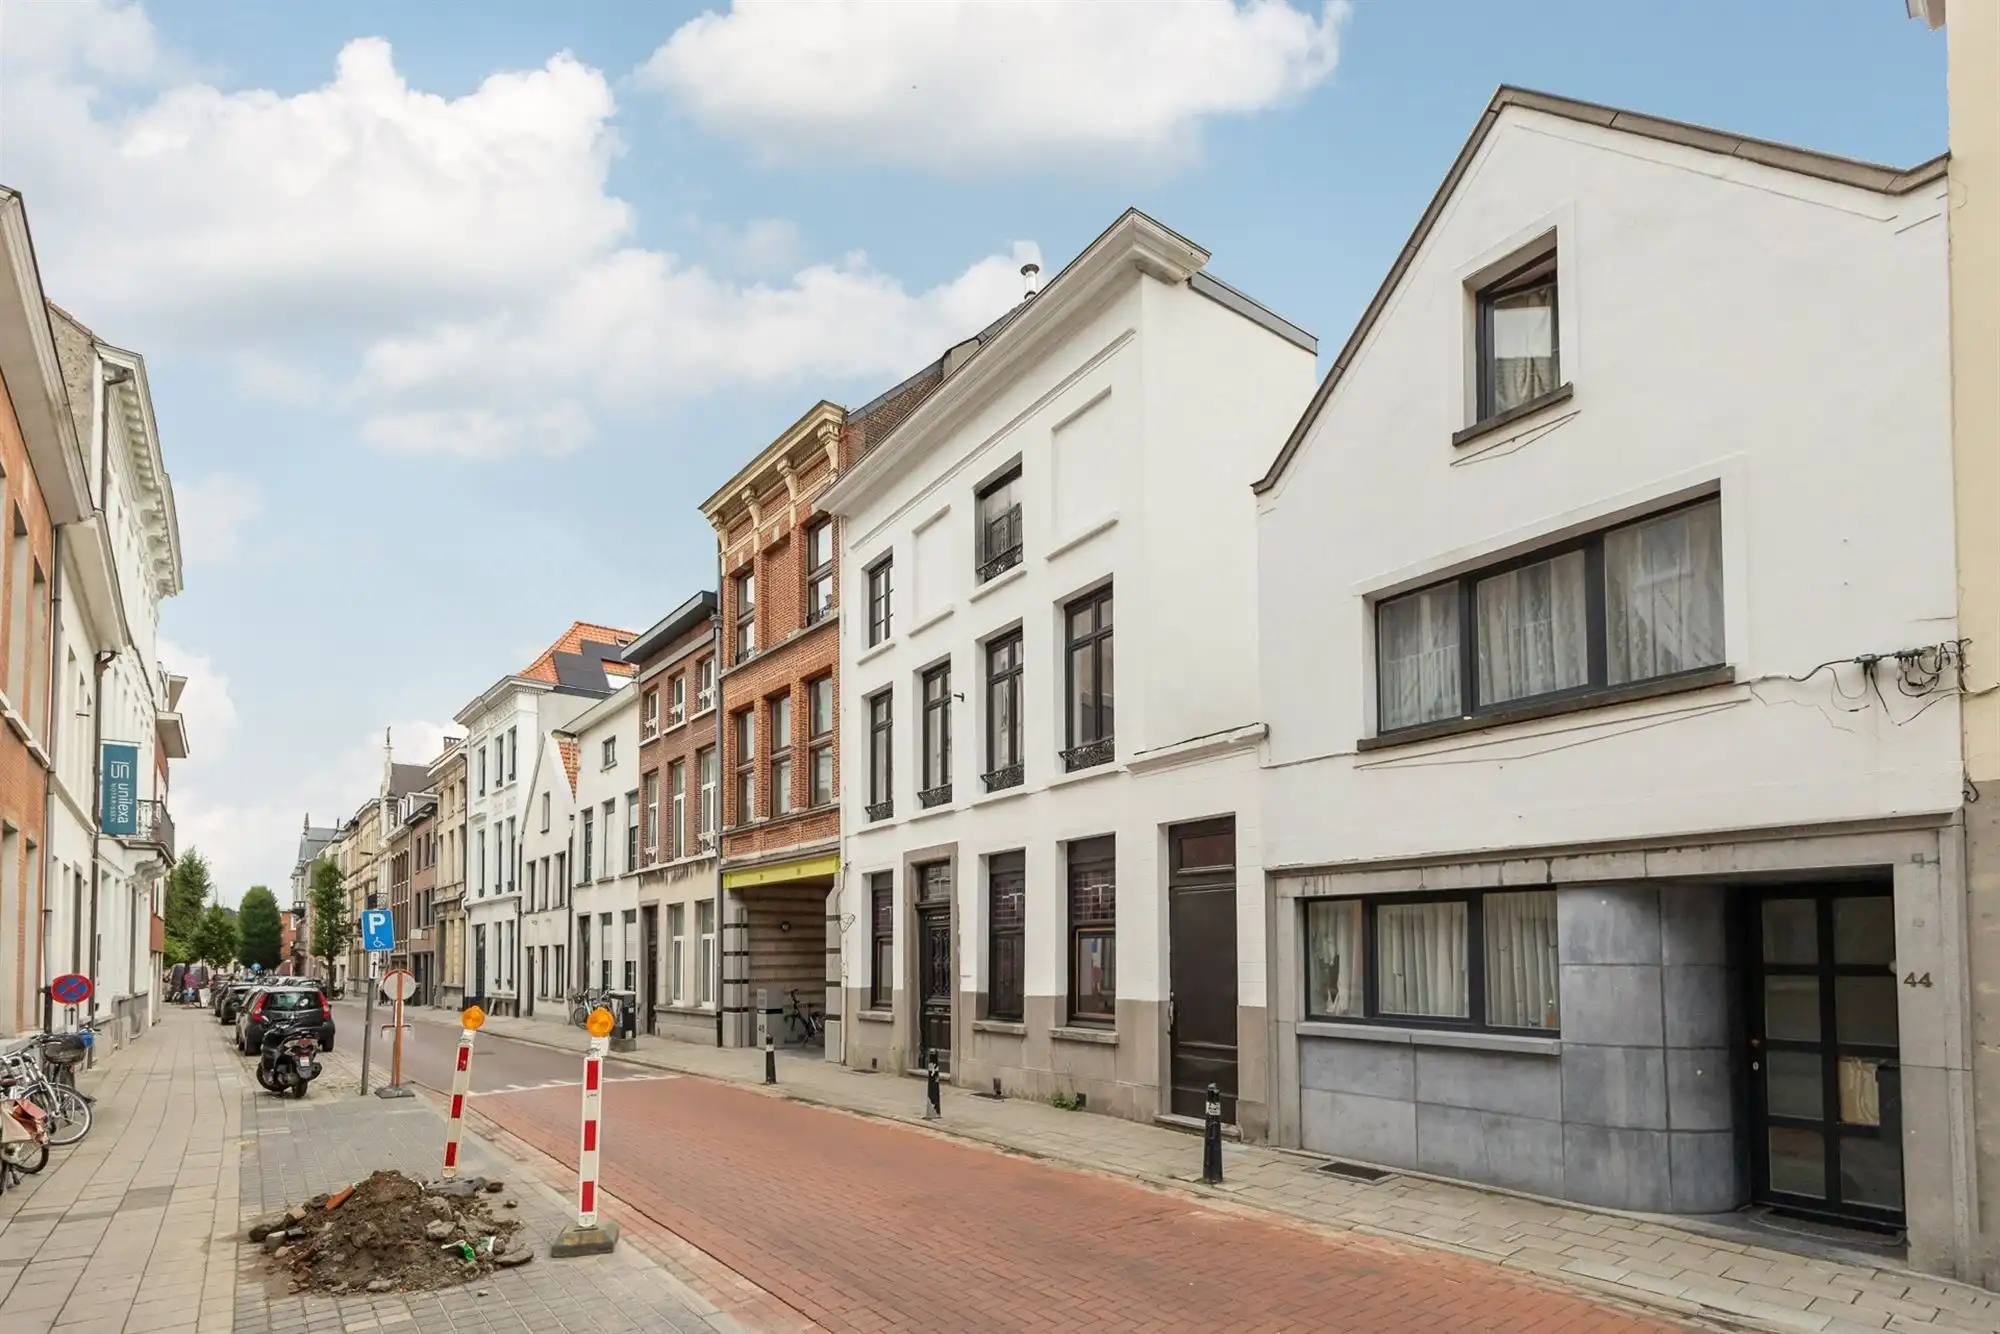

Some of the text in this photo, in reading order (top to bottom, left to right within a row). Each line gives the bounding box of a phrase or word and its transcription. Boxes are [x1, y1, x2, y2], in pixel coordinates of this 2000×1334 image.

[118, 783, 133, 824] unilexa
[369, 913, 386, 935] P
[1903, 971, 1933, 988] 44
